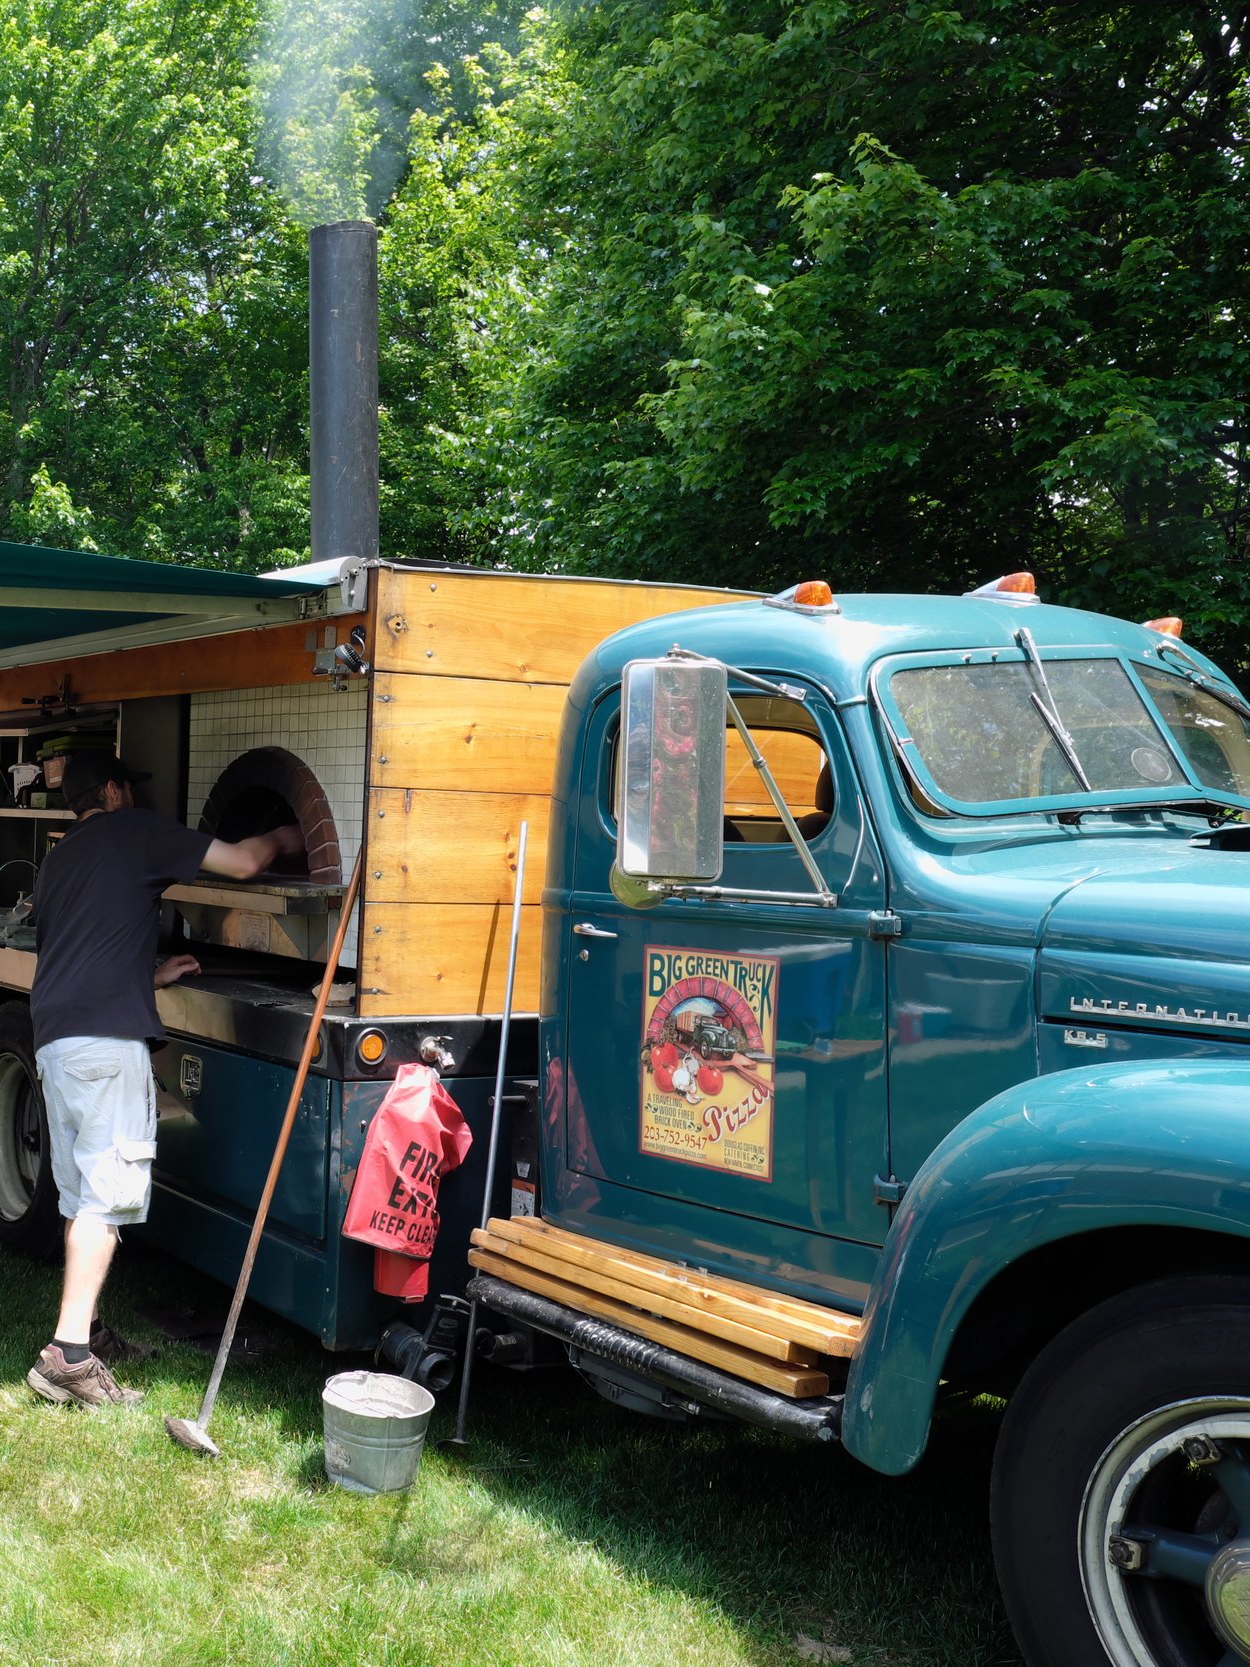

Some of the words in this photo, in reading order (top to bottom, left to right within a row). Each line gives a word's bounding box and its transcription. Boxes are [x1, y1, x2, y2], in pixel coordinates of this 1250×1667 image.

[649, 953, 682, 997] BIG
[685, 956, 729, 981] GREEN
[729, 960, 775, 1034] TRUCK
[1070, 996, 1250, 1027] INTERNATIO
[652, 1094, 682, 1108] TRAVELING
[659, 1105, 676, 1117] WOOD
[678, 1109, 695, 1121] FIRED
[703, 1083, 769, 1142] Pizza
[654, 1114, 671, 1126] BRICK
[672, 1118, 687, 1129] OVEN
[644, 1125, 707, 1150] 203-752-9547
[399, 1141, 440, 1188] FIR
[370, 1209, 405, 1236] KEEP
